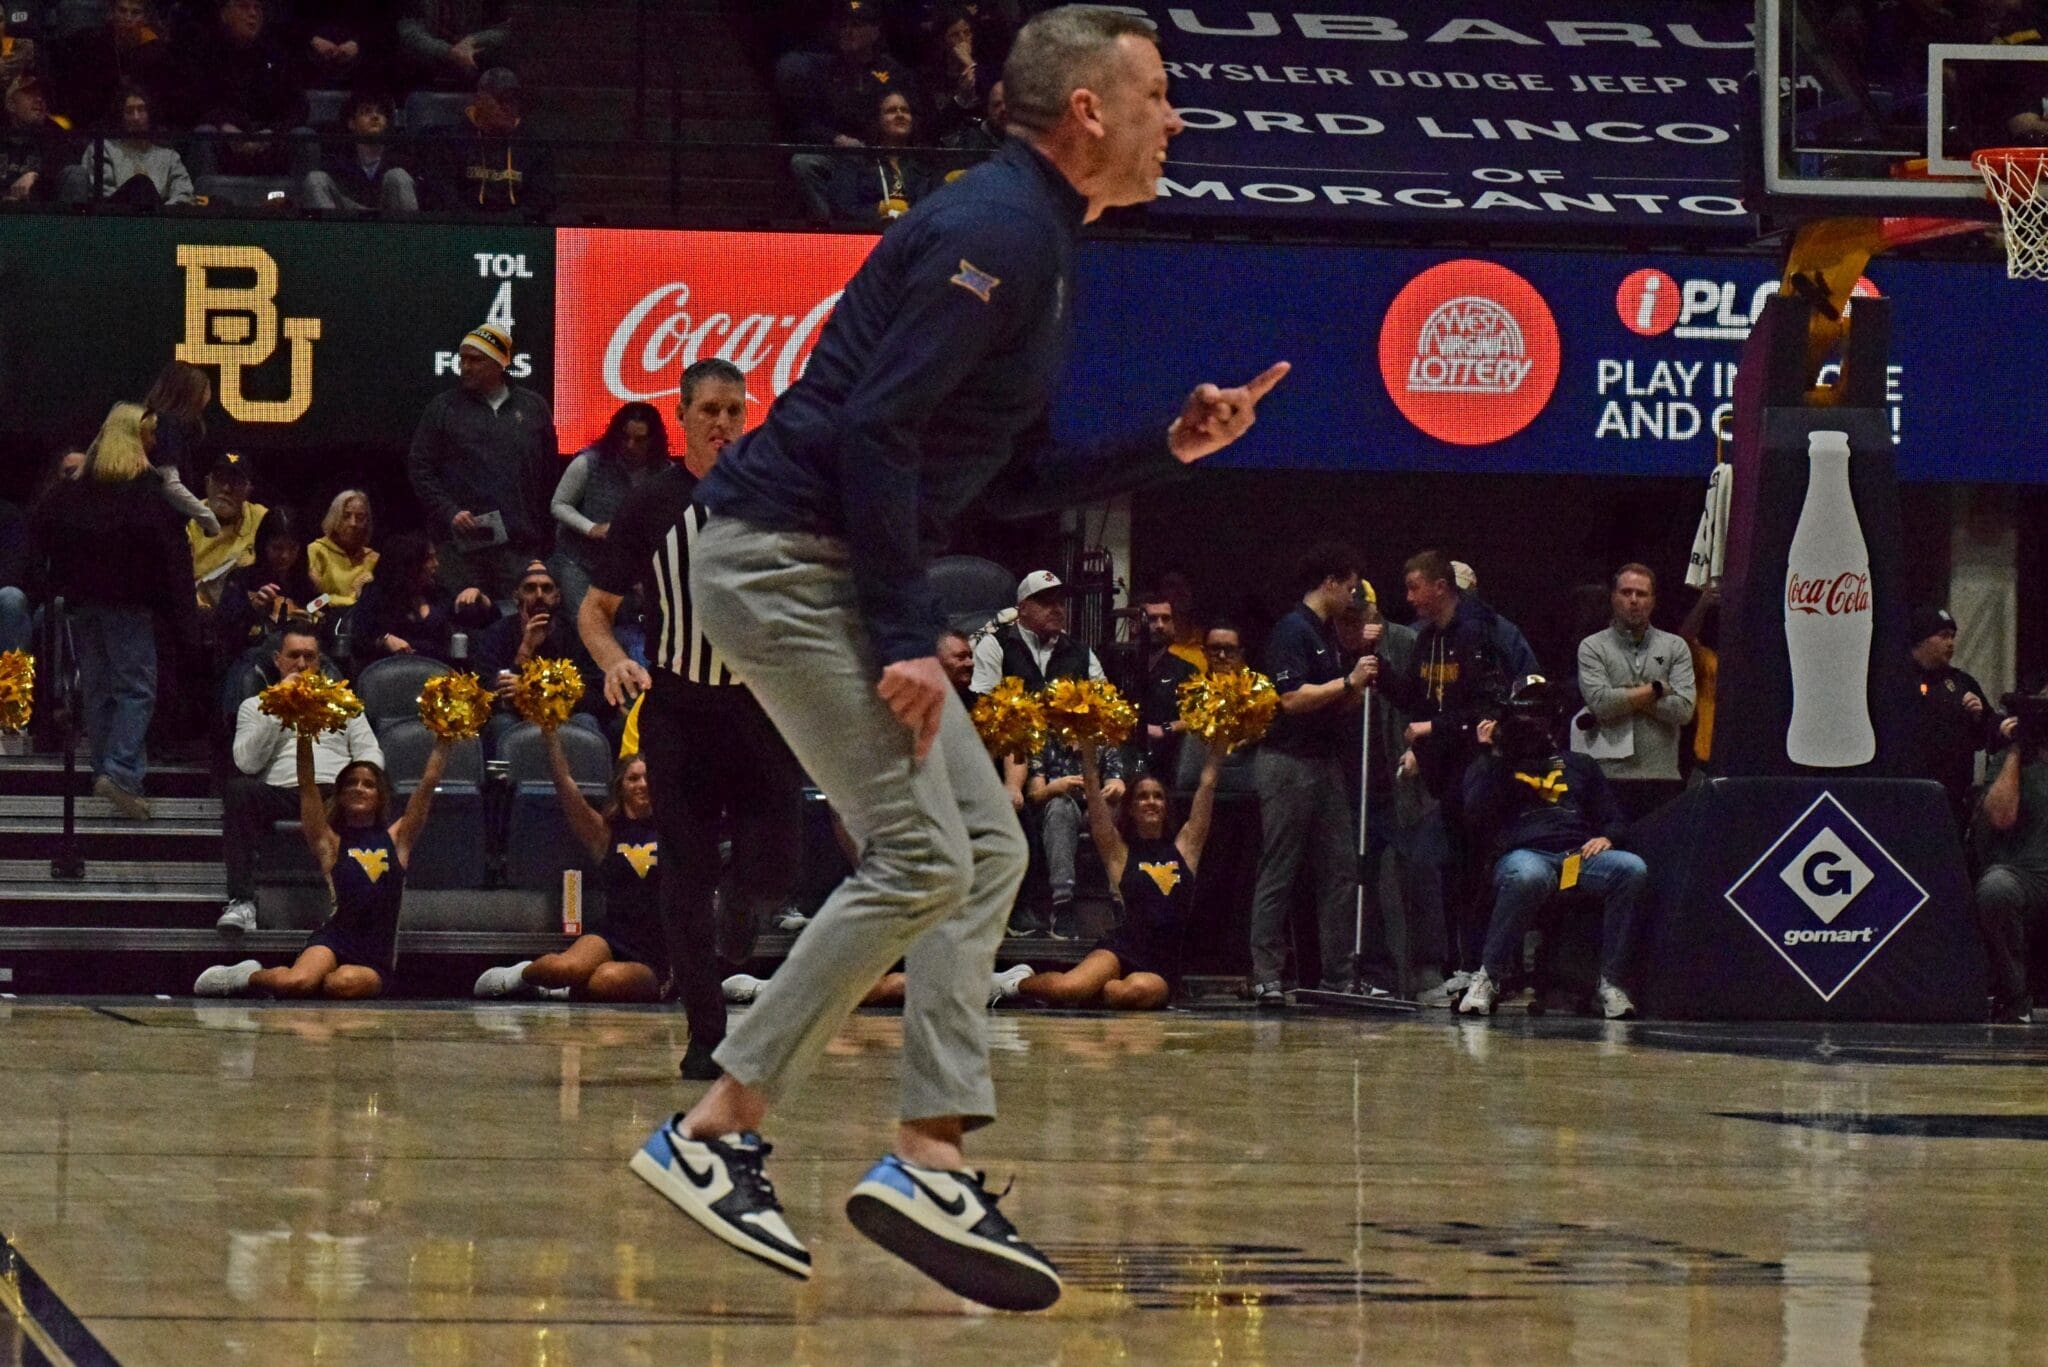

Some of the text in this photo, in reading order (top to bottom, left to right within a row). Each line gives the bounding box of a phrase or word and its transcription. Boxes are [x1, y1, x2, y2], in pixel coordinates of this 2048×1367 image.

[1161, 61, 1353, 85] RYSLER
[1368, 69, 1554, 92] DODGE
[1568, 74, 1687, 94] JEEP
[1172, 107, 1741, 144] ORD LINCO
[1471, 167, 1565, 184] OF
[1156, 177, 1747, 216] MORGANTO
[474, 253, 533, 278] TOL
[486, 280, 516, 337] 4
[1406, 356, 1533, 393] LOTTERY
[1597, 359, 1704, 397] PLAY
[1595, 400, 1702, 441] AND
[1788, 571, 1870, 616] Coca-Cola
[1803, 850, 1852, 897] G
[1784, 926, 1874, 945] gomart
